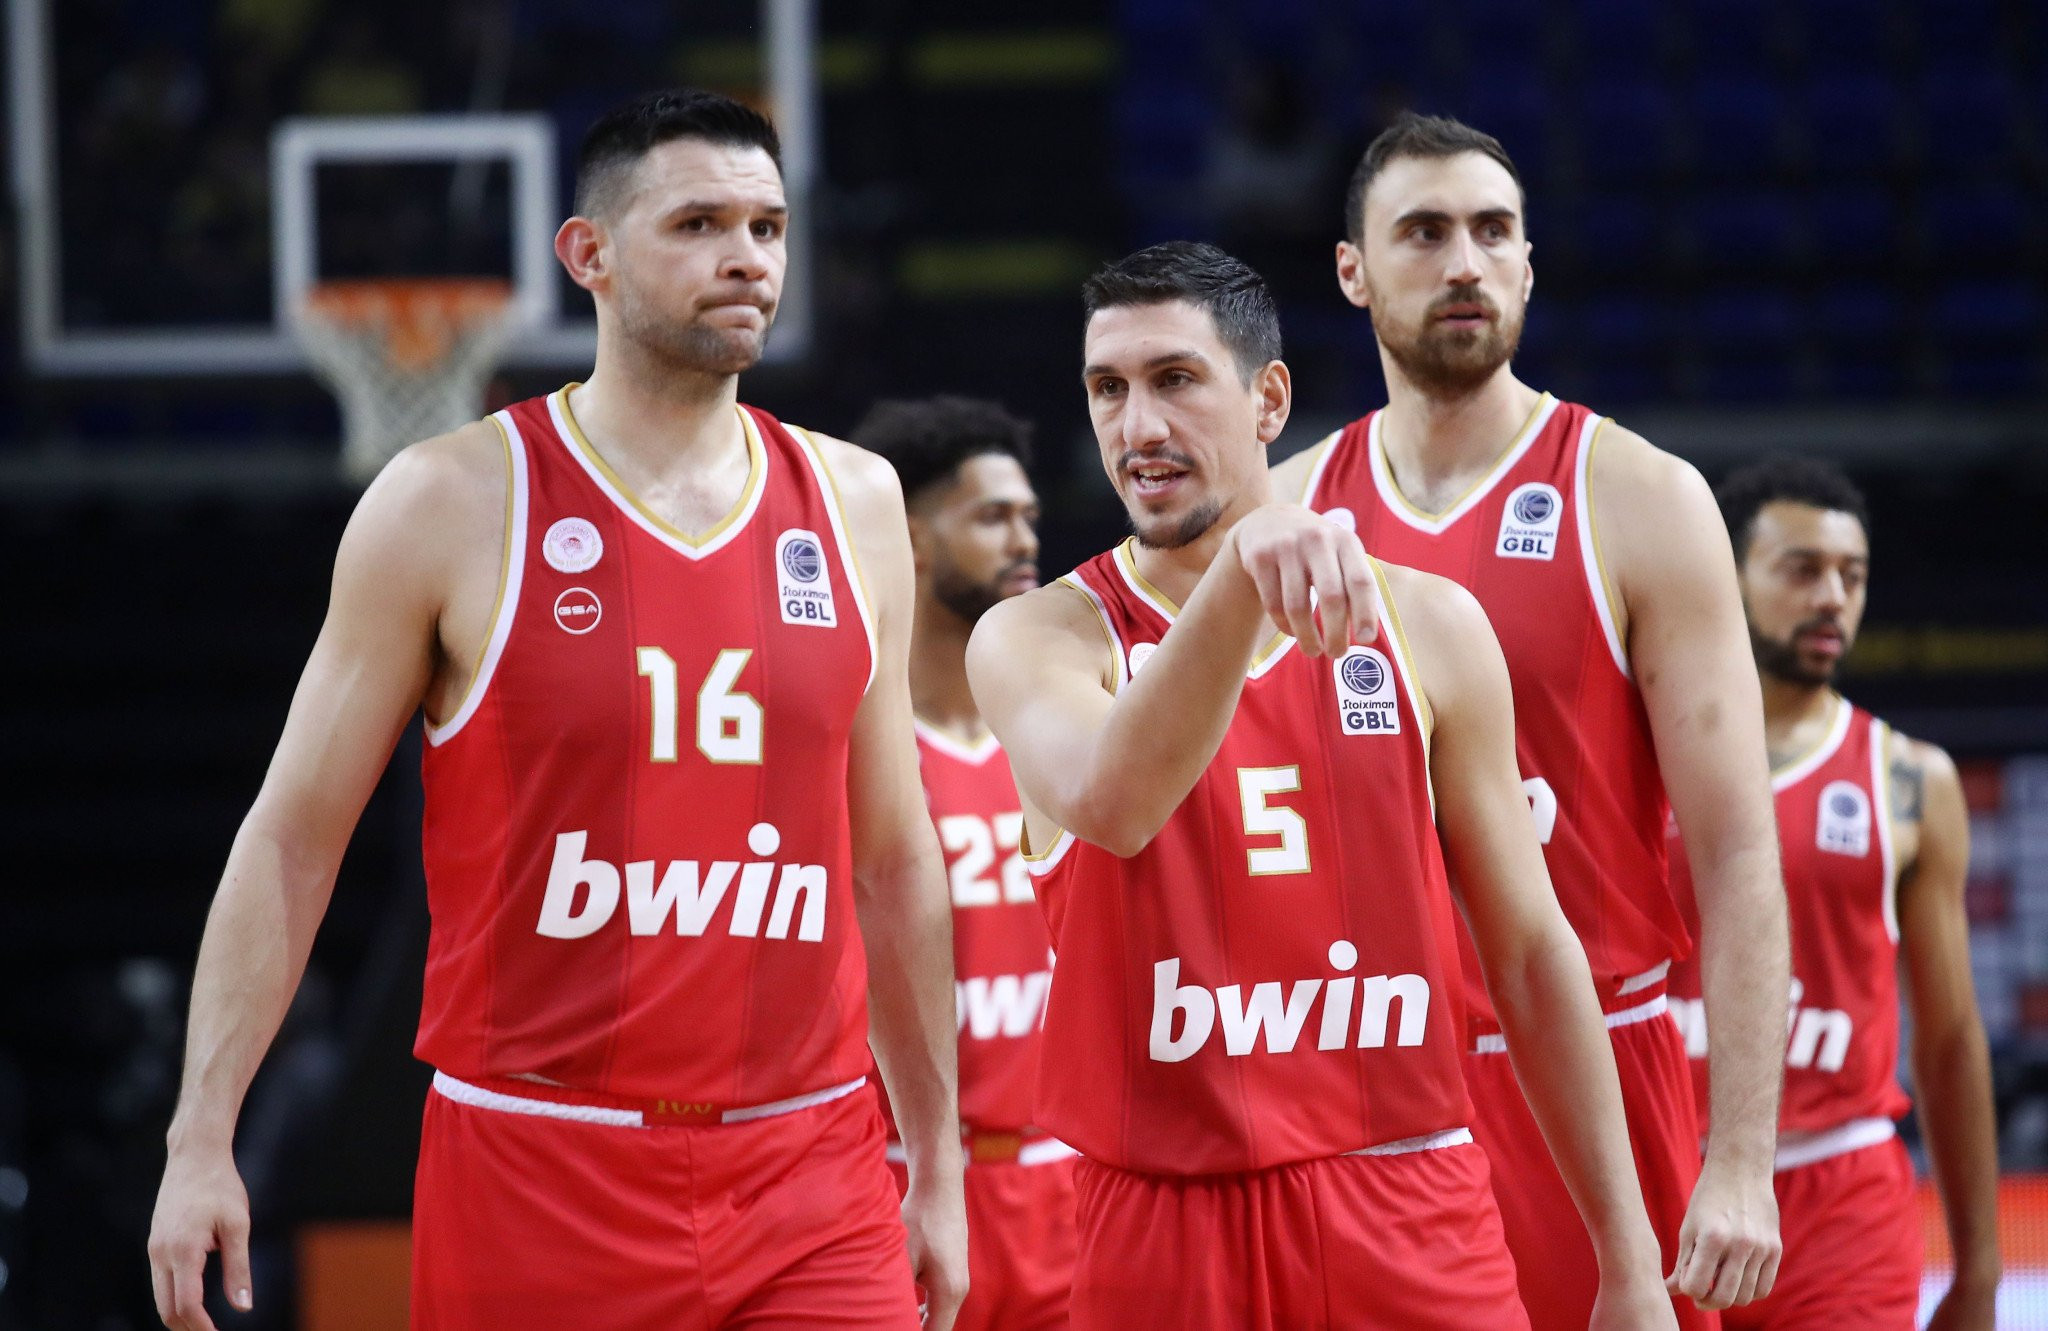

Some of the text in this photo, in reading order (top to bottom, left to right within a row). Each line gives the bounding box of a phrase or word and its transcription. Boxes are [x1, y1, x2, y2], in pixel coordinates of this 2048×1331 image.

[1503, 537, 1548, 554] GBL
[786, 599, 831, 621] GBL
[636, 646, 764, 765] 16
[1342, 699, 1395, 710] Stoiximan
[1346, 711, 1395, 729] GBL
[1236, 764, 1312, 877] 5
[535, 822, 828, 942] bwin
[1149, 939, 1430, 1063] bwin
